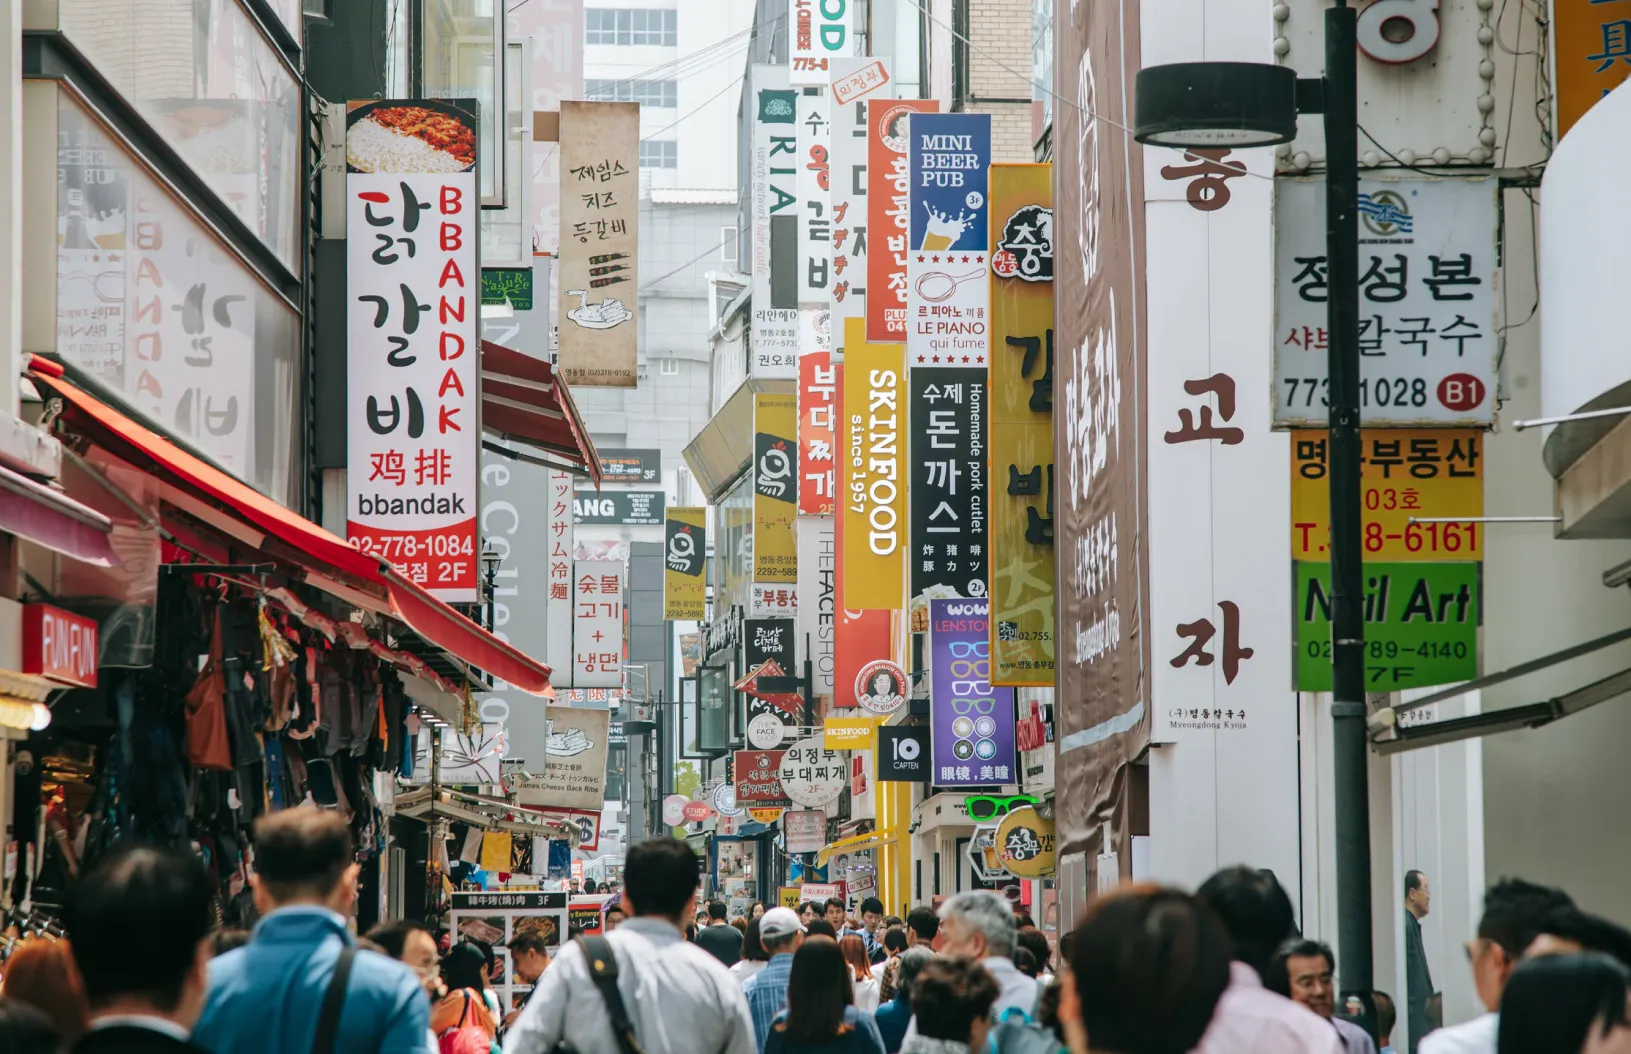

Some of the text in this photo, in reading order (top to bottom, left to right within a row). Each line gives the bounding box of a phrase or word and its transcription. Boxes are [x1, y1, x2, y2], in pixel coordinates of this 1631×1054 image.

[796, 9, 811, 51] CHINESE
[839, 70, 879, 97] 의정부
[921, 134, 972, 151] MINI
[570, 159, 630, 183] 제임스
[921, 153, 980, 170] BEER
[921, 171, 964, 187] PUB
[582, 192, 617, 210] 치즈
[969, 195, 980, 205] 3F
[573, 217, 627, 244] 등갈비
[1292, 253, 1482, 303] 정성본
[357, 181, 432, 438] 닭갈비
[438, 185, 465, 434] BBANDAK
[931, 305, 962, 318] 피아노
[918, 322, 985, 335] LE PIANO
[930, 336, 985, 351] qui fume
[923, 383, 963, 404] 수제
[1446, 380, 1477, 404] B1
[368, 447, 453, 487] 鸡排
[850, 414, 867, 513] since 1957
[869, 369, 897, 556] SKINFOOD
[967, 384, 984, 534] Homemade pork cutlet
[1297, 438, 1479, 479] 명부동산
[643, 469, 656, 480] 3F
[924, 410, 962, 533] 돈까스
[358, 493, 466, 516] bbandak
[348, 535, 474, 557] 02-778-1084
[438, 562, 467, 582] 2F
[578, 574, 620, 595] 숯불
[971, 582, 983, 592] 2F
[1304, 574, 1471, 623] Nil Art
[578, 602, 620, 619] 고기
[577, 653, 620, 673] 냉면
[1366, 667, 1416, 683] 7F
[826, 727, 870, 736] SKINFOOD
[1169, 720, 1247, 729] Myeongdong Kyoja
[788, 747, 837, 765] 의정부
[892, 737, 920, 761] 10
[781, 765, 846, 784] 부대찌개
[893, 761, 919, 770] CAPTEN
[519, 782, 540, 790] James
[537, 896, 549, 906] 3F
